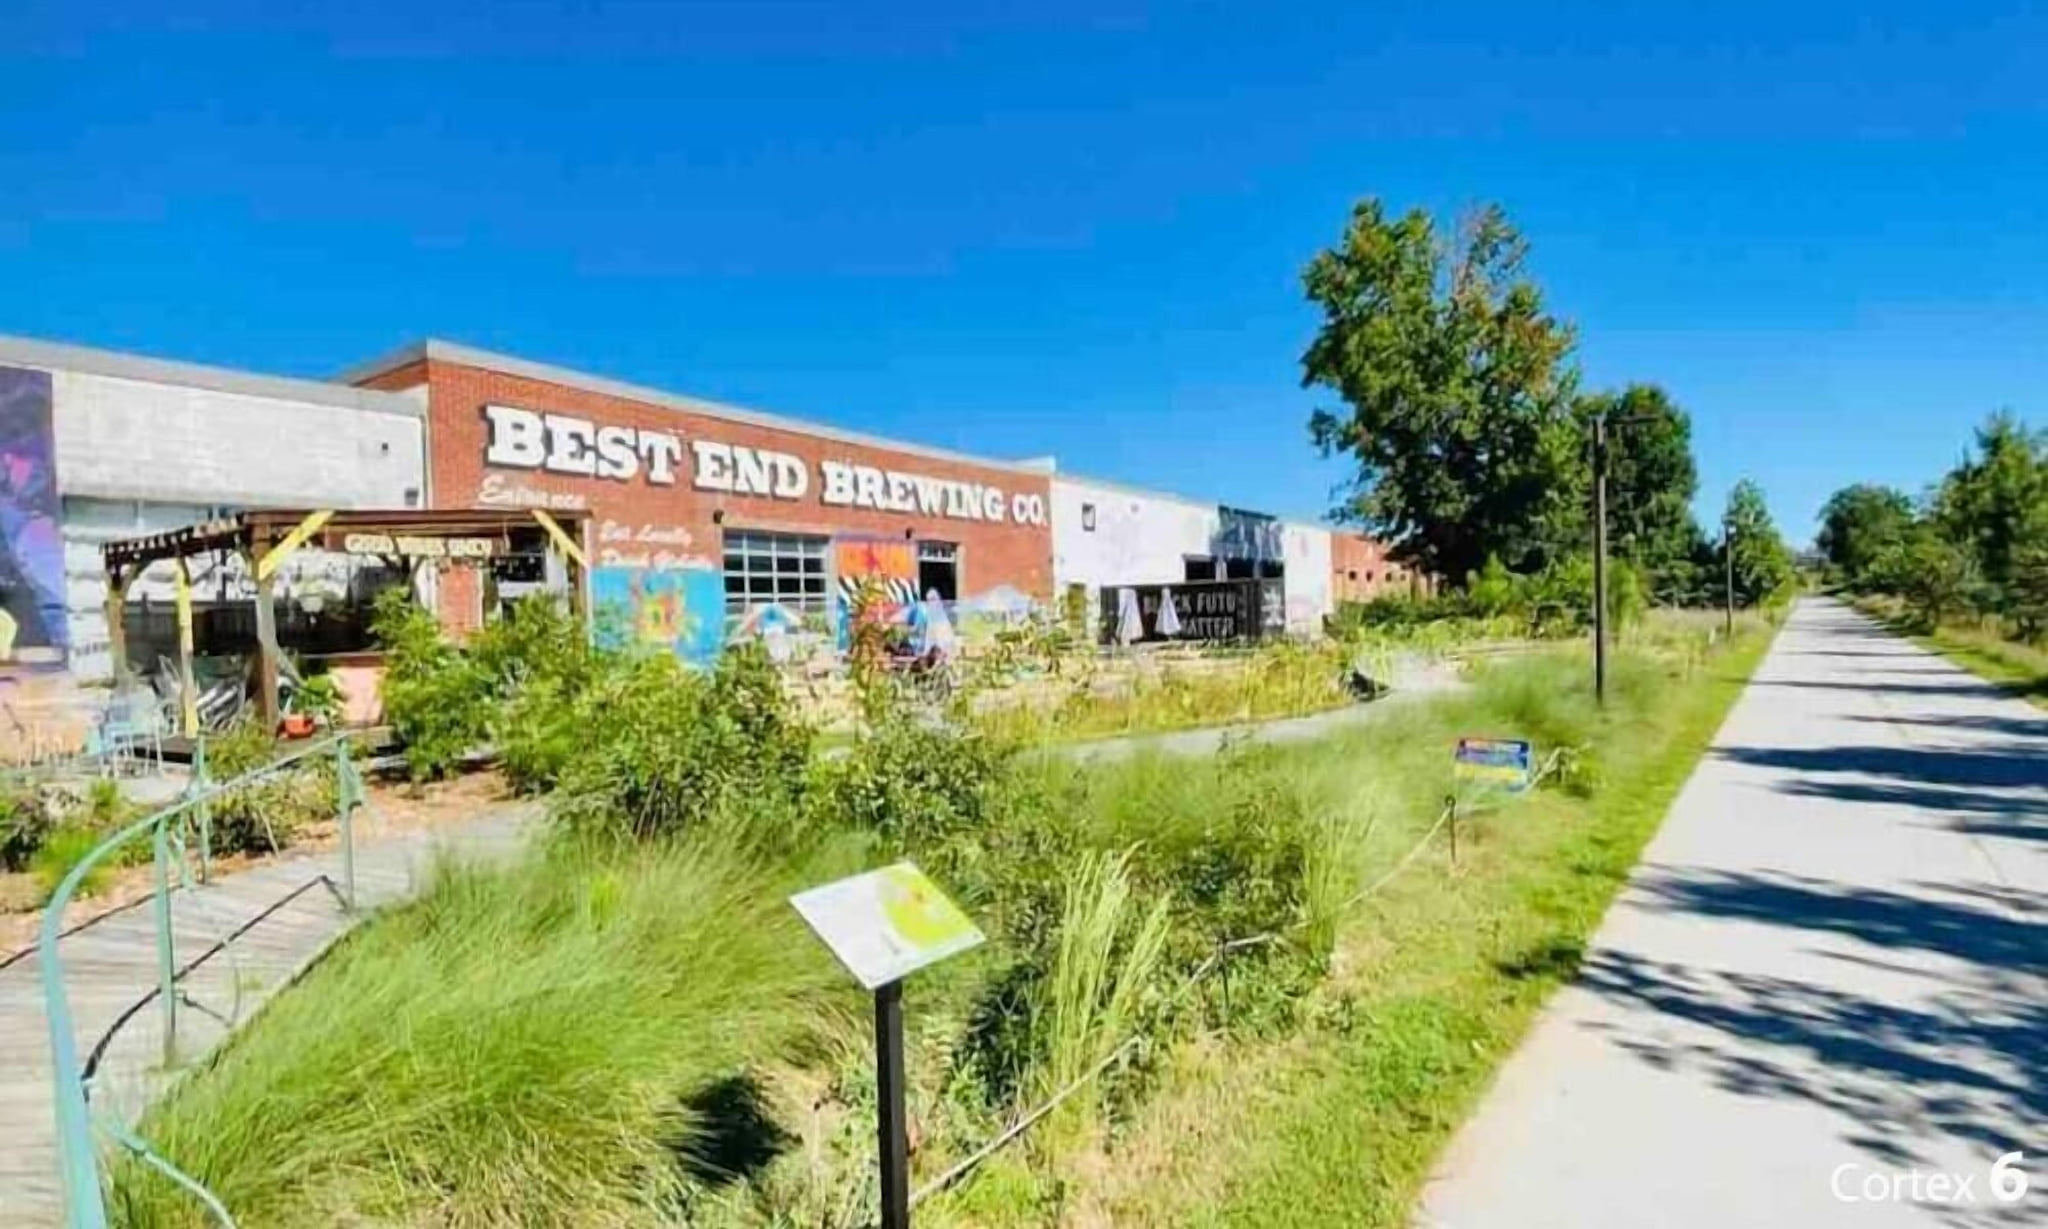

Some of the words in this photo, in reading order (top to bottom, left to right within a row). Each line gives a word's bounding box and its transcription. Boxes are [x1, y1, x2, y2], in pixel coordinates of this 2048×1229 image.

[486, 404, 682, 485] BEST
[694, 439, 809, 499] END
[821, 460, 1007, 522] BREWING
[1013, 493, 1049, 528] CO.
